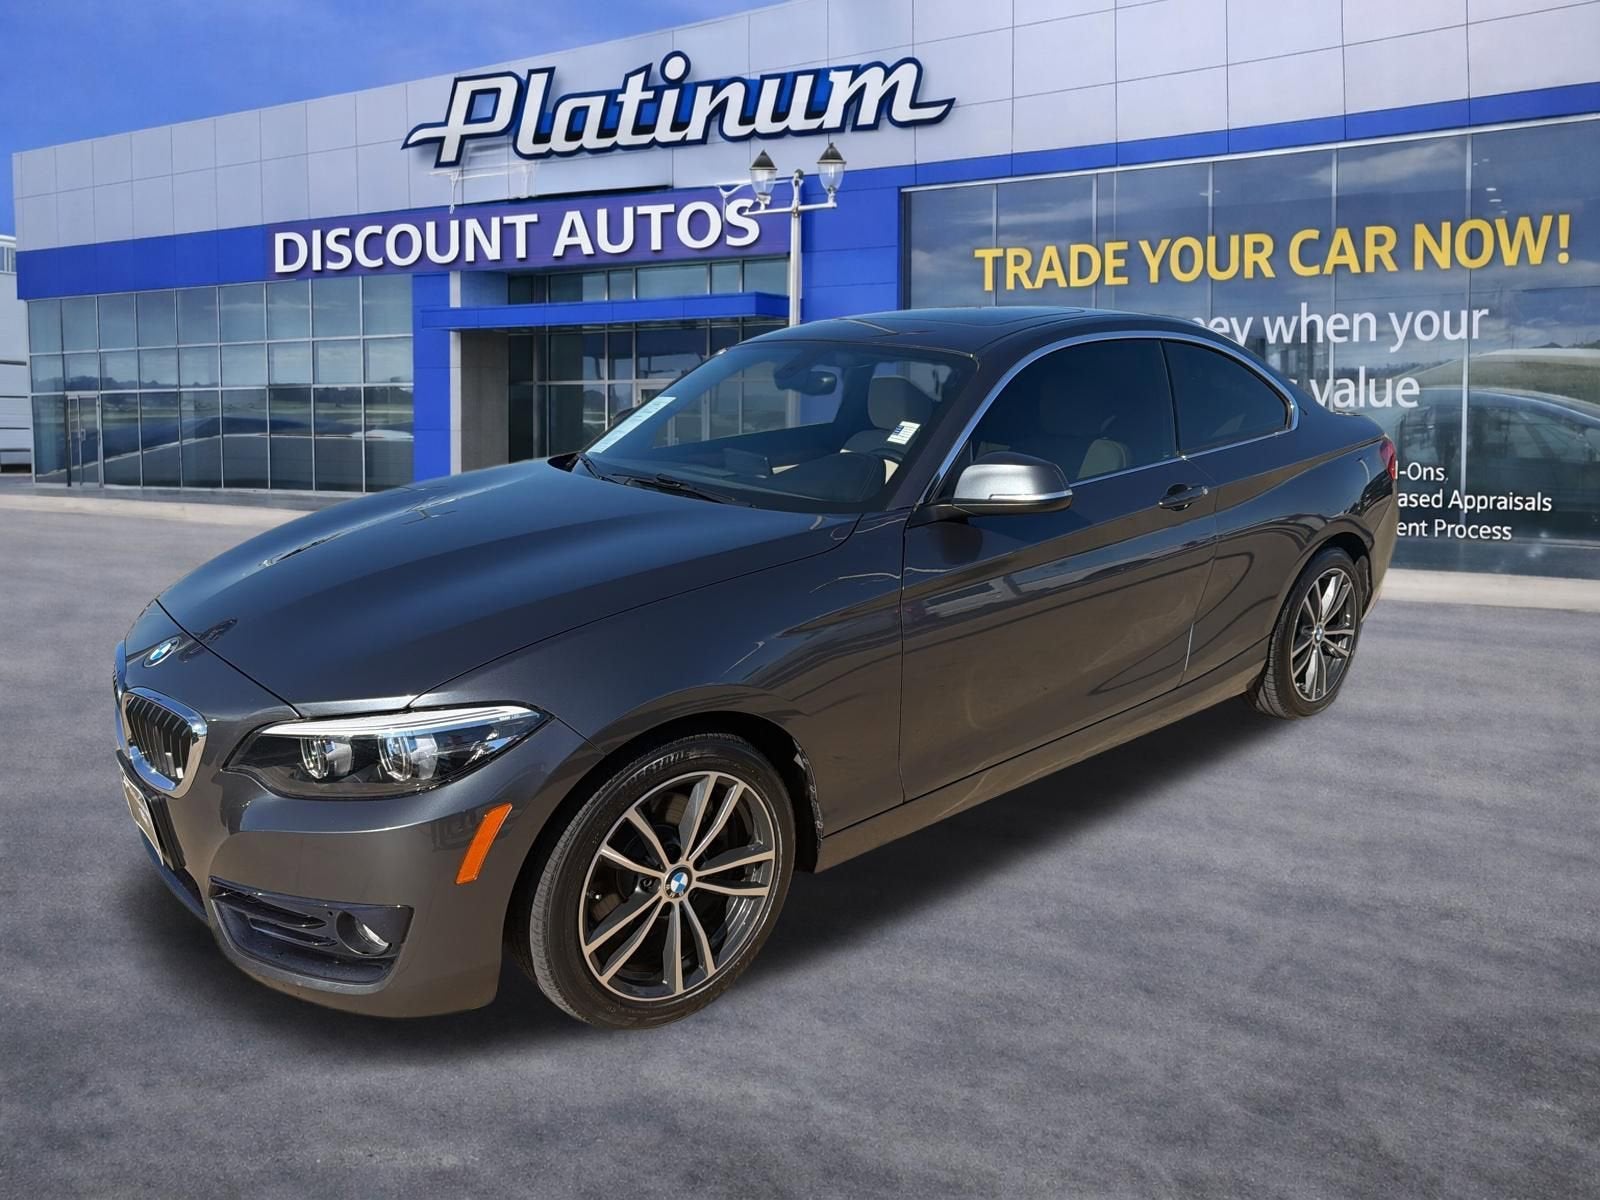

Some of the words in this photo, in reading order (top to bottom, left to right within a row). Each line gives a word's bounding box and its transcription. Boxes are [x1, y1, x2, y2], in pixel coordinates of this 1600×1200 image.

[402, 51, 955, 167] Platinum
[274, 213, 538, 273] DISCOUNT
[552, 198, 760, 257] AUTOS
[974, 241, 1129, 292] TRADE
[1138, 233, 1276, 284] YOUR
[1288, 225, 1399, 277] CAR
[1413, 213, 1571, 271] NOW!
[1262, 302, 1377, 345] when
[1387, 308, 1489, 354] your
[1309, 365, 1421, 409] value
[1447, 489, 1553, 514] Appraisals
[1434, 518, 1513, 541] Process
